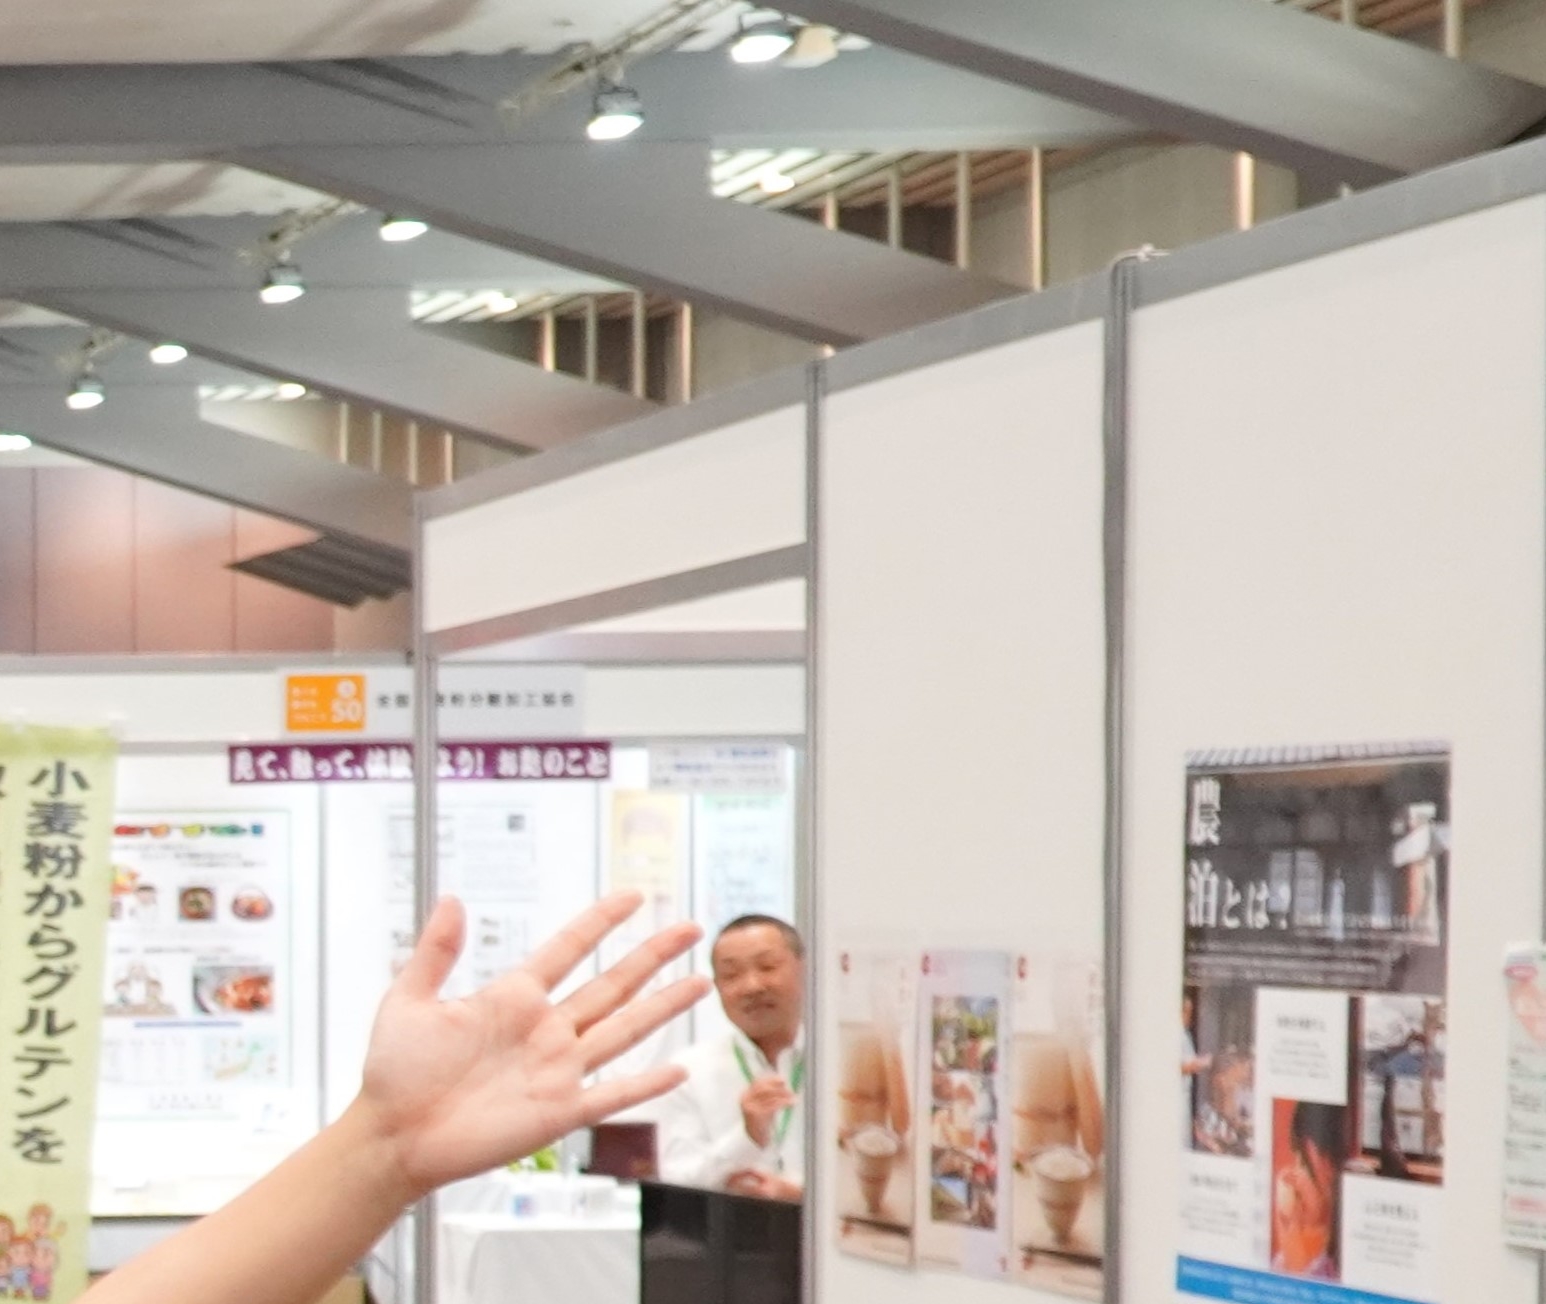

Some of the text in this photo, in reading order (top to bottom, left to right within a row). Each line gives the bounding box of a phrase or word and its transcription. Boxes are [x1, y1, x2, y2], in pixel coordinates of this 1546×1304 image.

[13, 760, 89, 1164] 小麦粉からグルテンを
